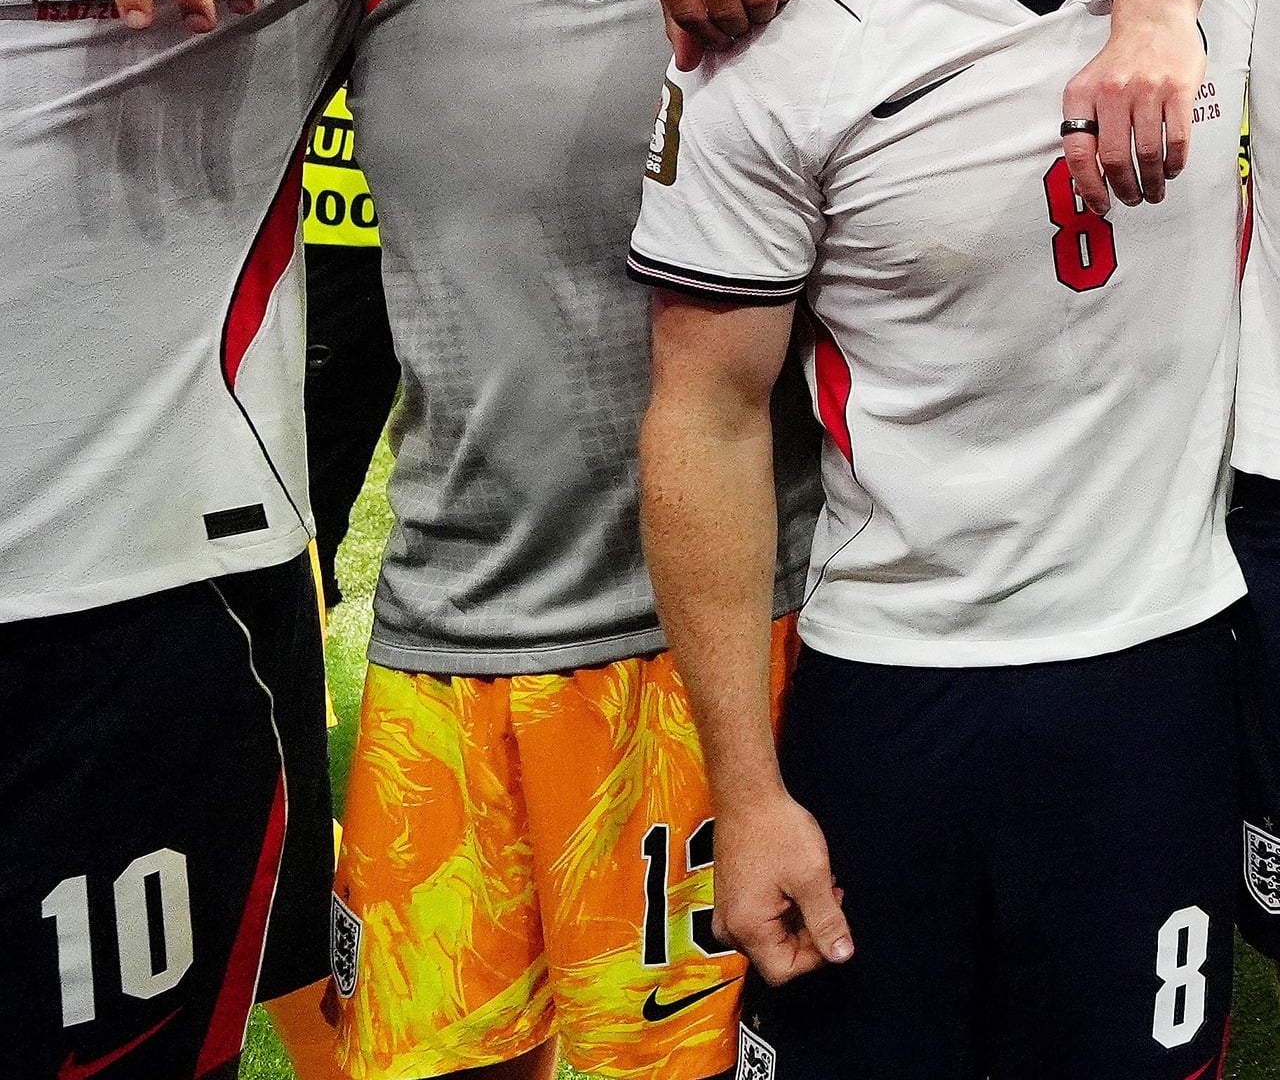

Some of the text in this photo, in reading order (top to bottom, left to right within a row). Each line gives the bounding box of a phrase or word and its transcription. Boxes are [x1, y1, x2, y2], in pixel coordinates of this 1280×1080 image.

[1191, 103, 1221, 124] .07.26
[1042, 155, 1118, 293] 8
[41, 847, 194, 1028] 10
[1151, 904, 1210, 1050] 8
